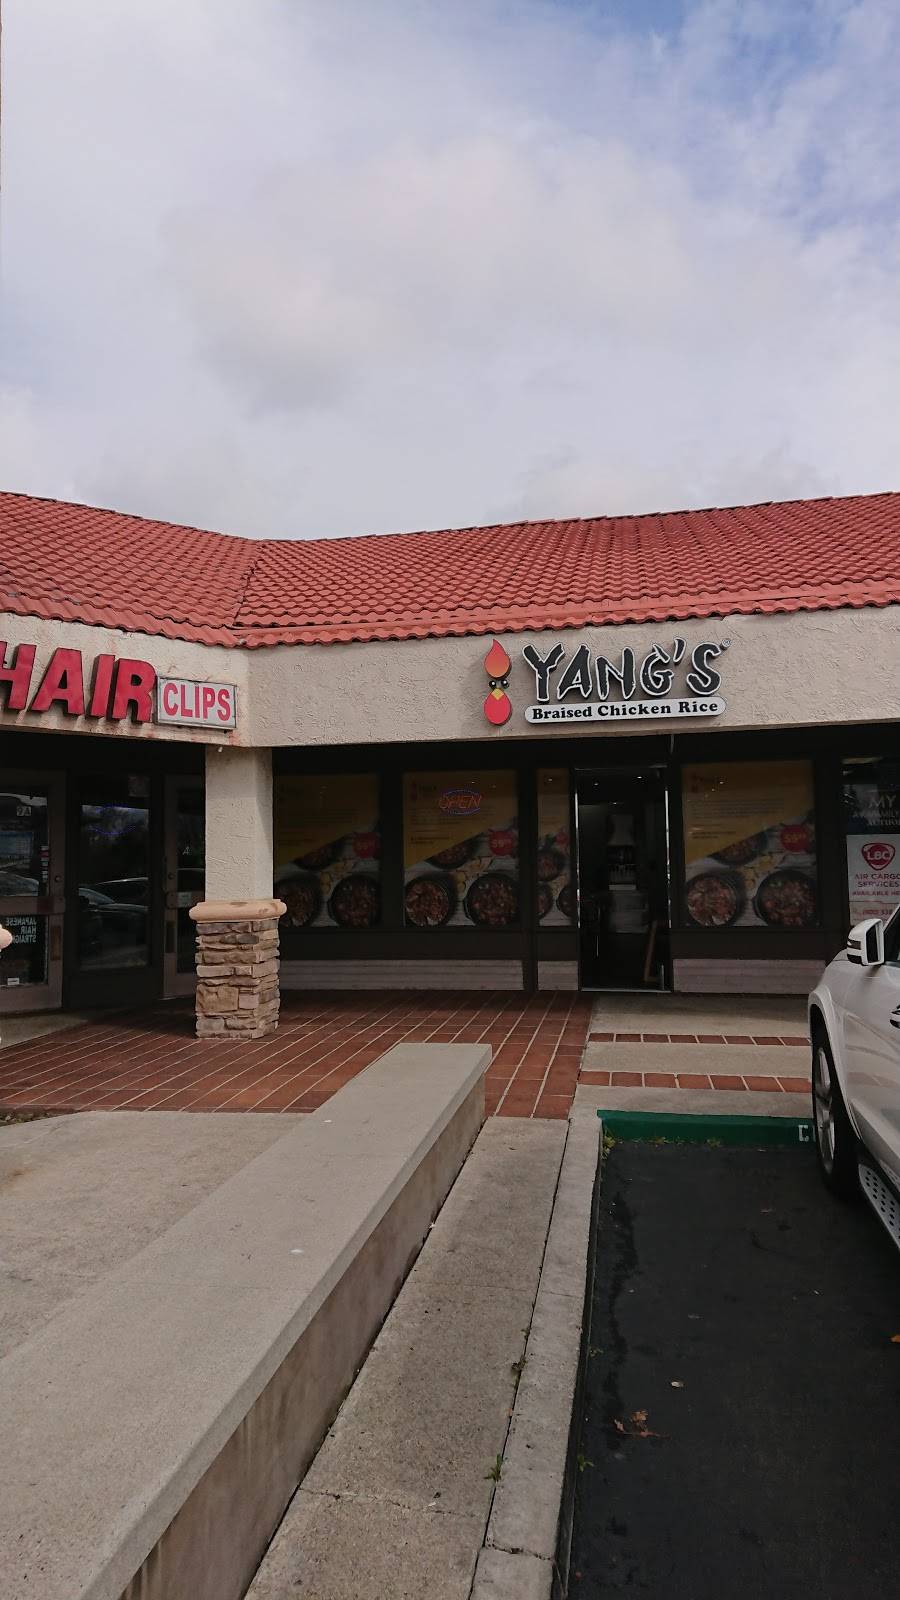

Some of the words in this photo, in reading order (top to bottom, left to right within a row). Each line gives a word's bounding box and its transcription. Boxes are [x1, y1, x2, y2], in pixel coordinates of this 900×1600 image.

[522, 638, 722, 702] YANG'S
[0, 641, 157, 722] HAIR
[162, 682, 232, 722] CLIPS
[532, 706, 593, 720] Braised
[597, 703, 672, 717] Chicken
[678, 701, 719, 713] Rice
[438, 794, 483, 809] OPEN
[866, 850, 891, 861] LBC
[857, 880, 900, 888] SERVICES
